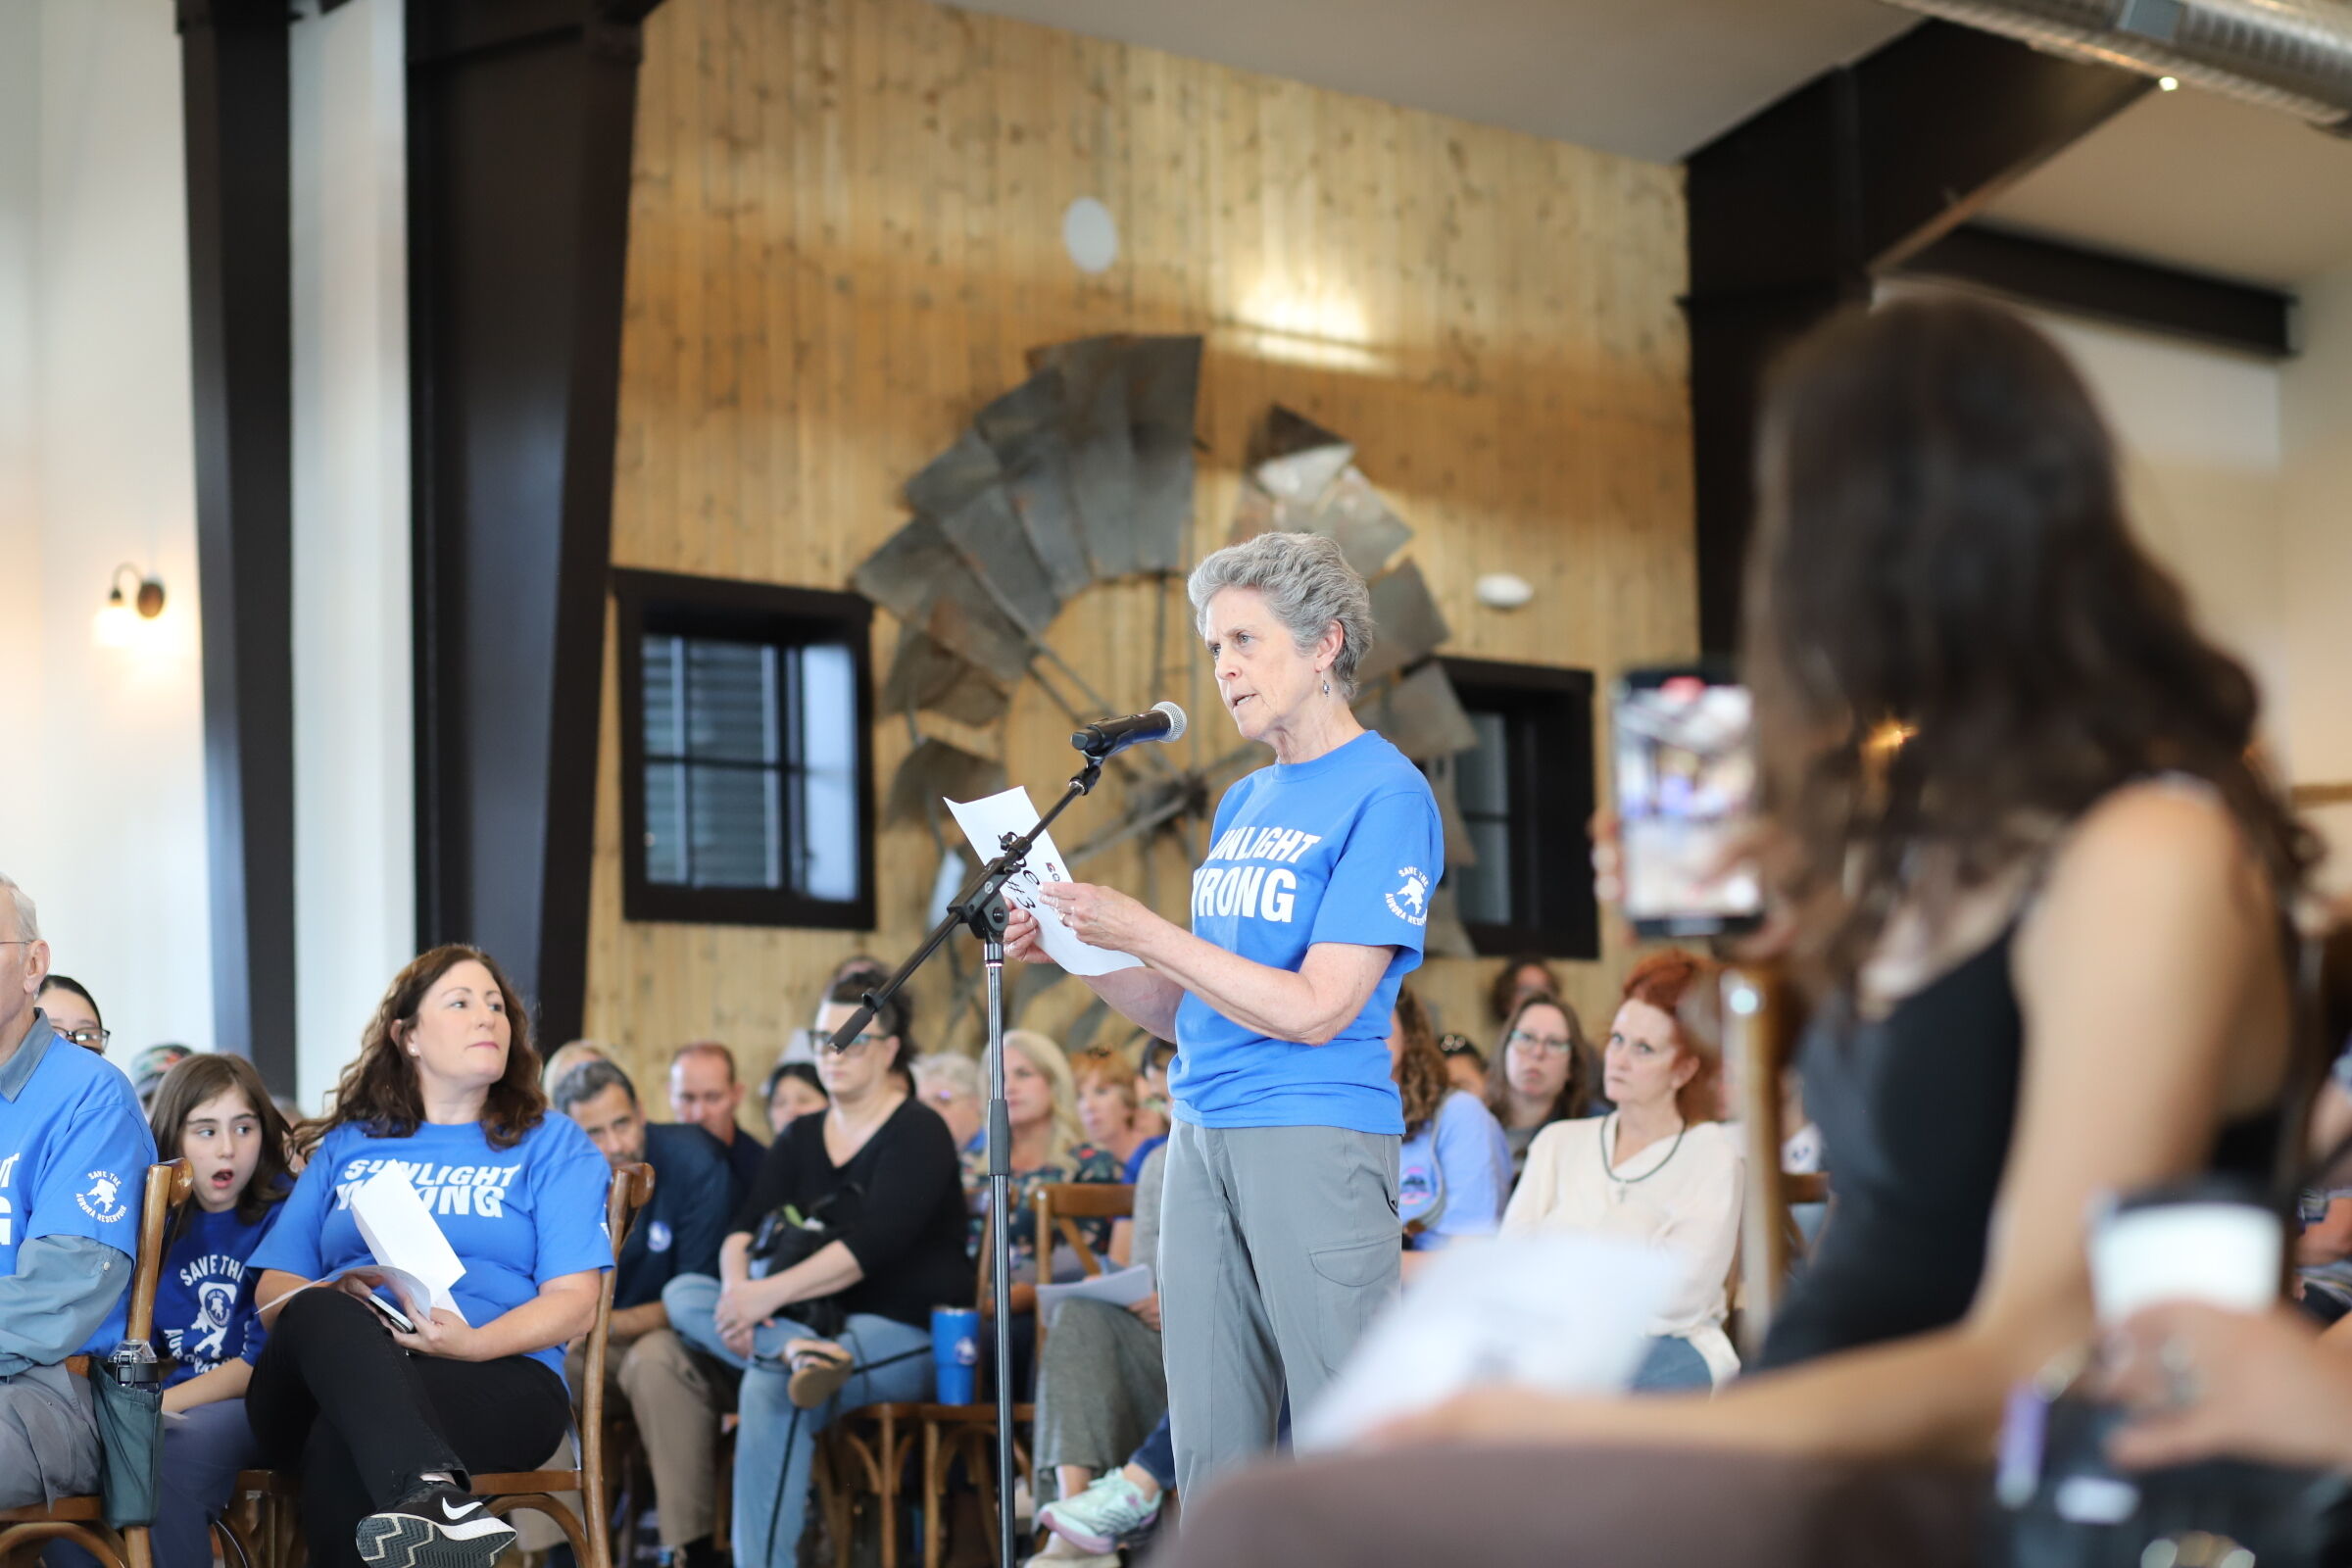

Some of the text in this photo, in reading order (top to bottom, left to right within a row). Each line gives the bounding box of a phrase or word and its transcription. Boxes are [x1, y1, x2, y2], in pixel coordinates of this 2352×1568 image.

[1398, 866, 1429, 887] SAVE THE
[1385, 893, 1406, 919] AURORA
[87, 1170, 122, 1188] SAVE THE
[75, 1193, 127, 1224] AURORA RESERVOIR
[180, 1254, 219, 1287] SAVE
